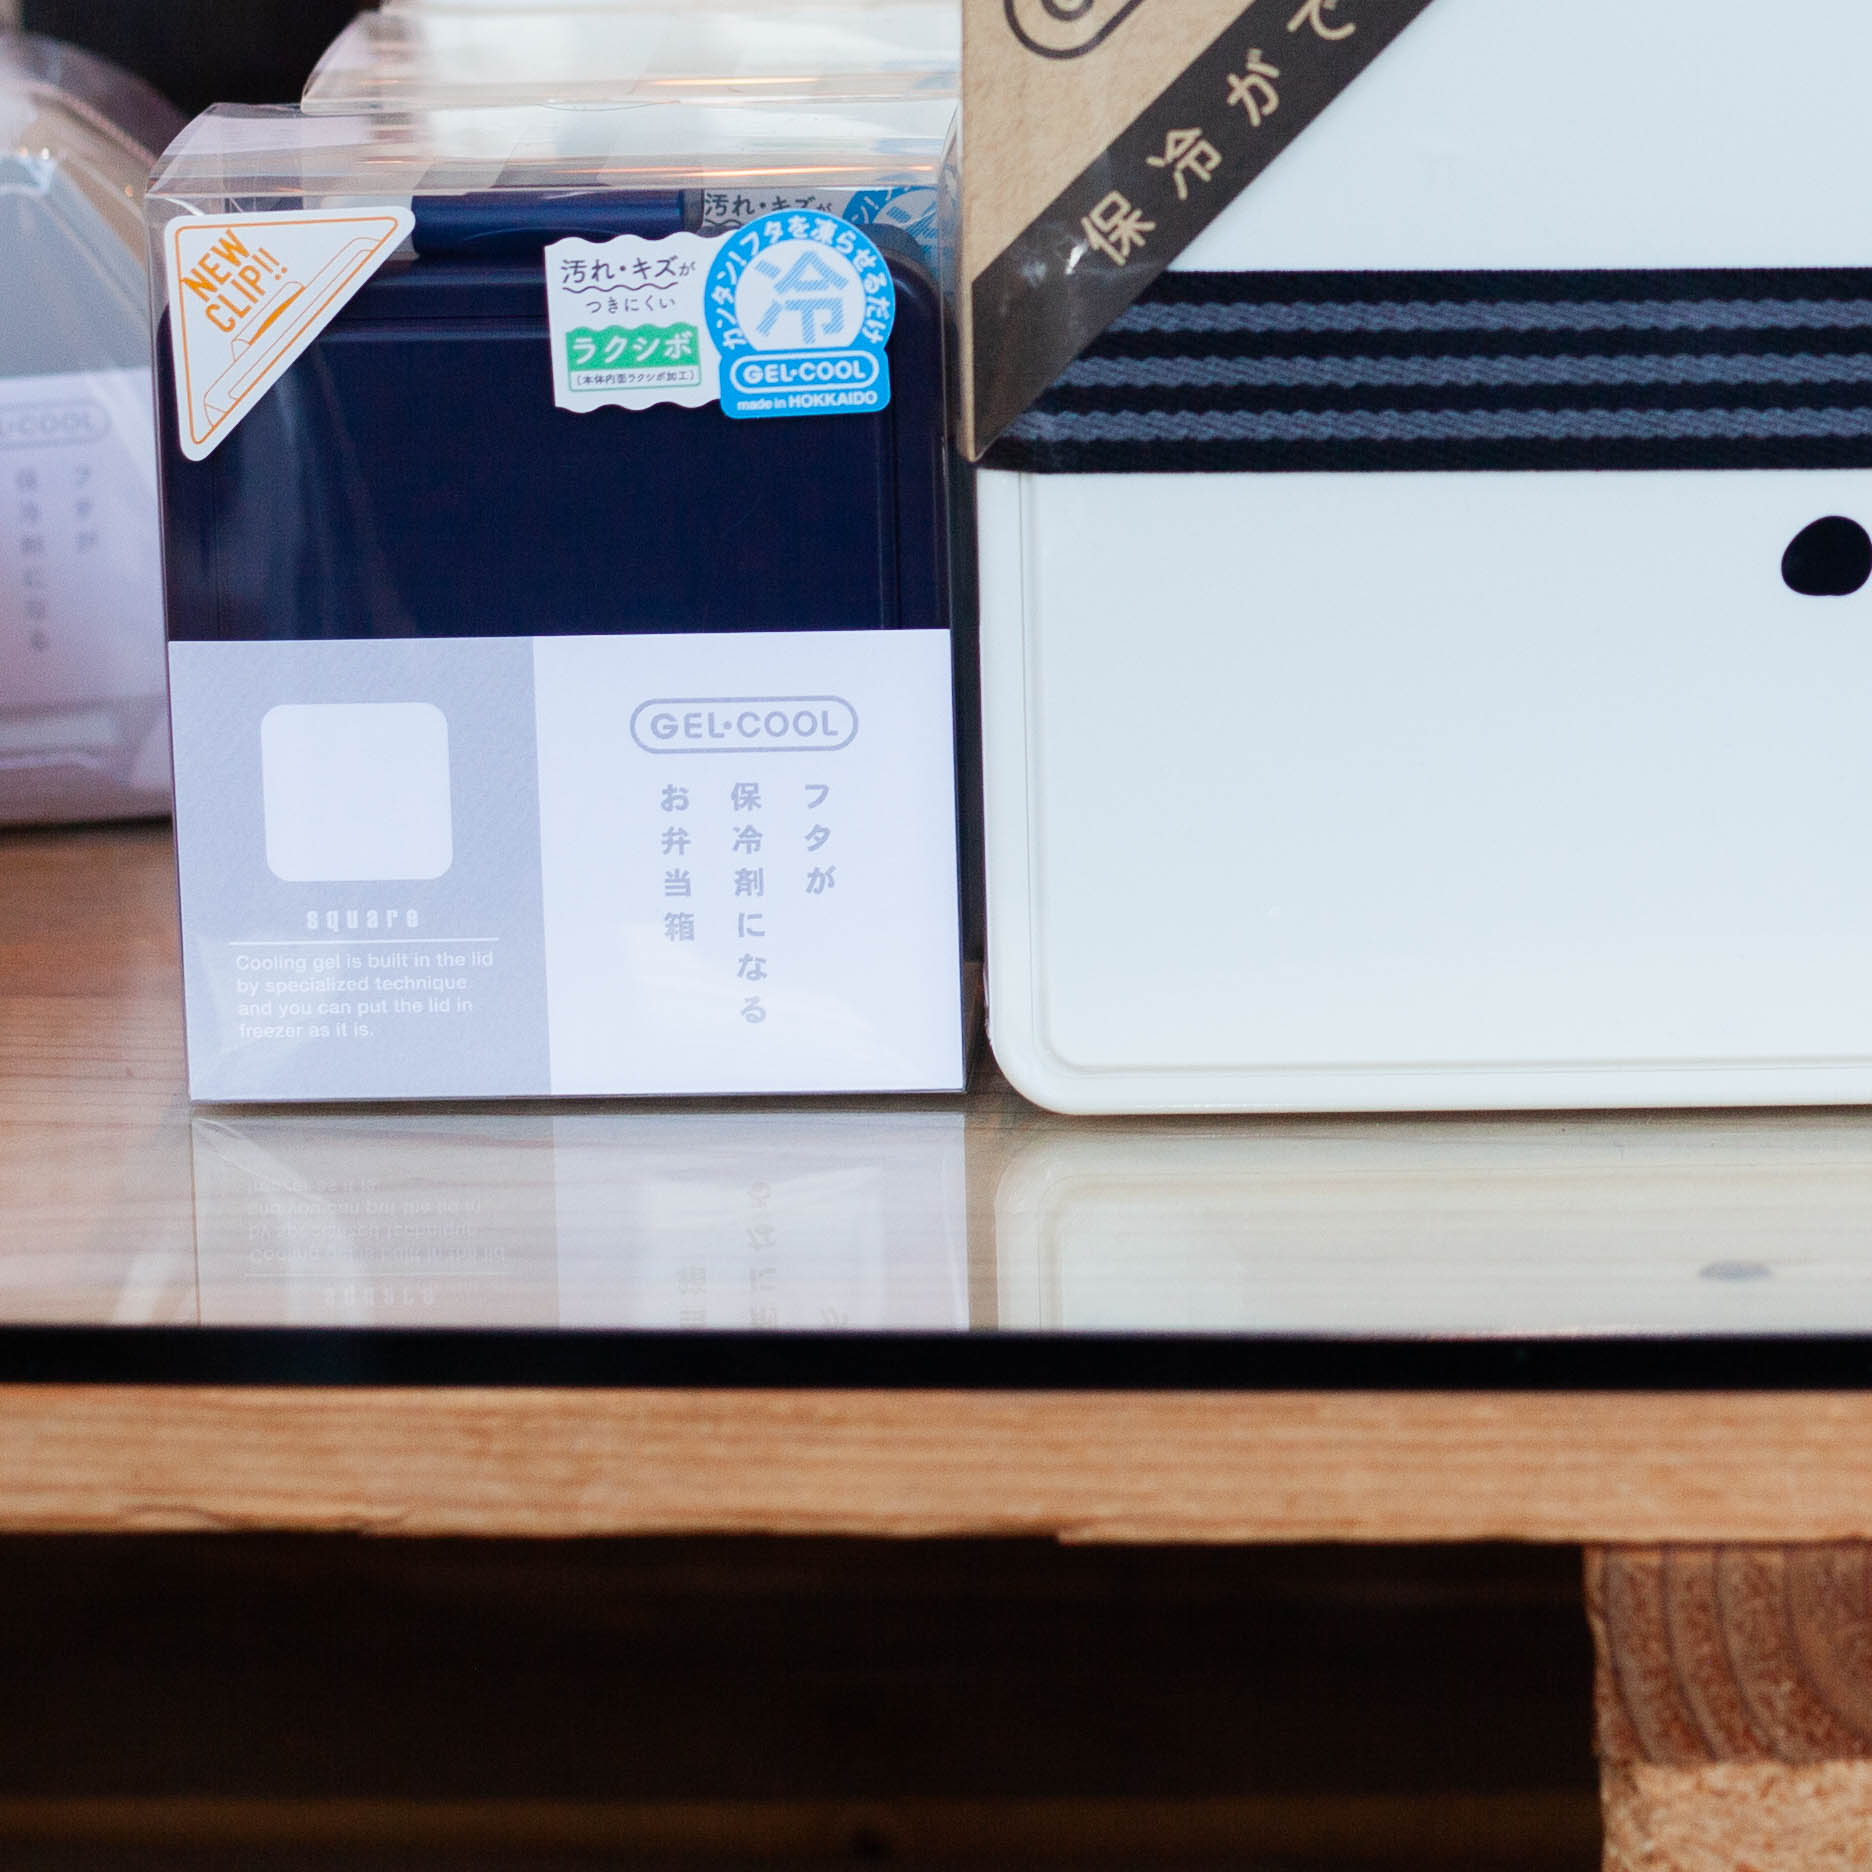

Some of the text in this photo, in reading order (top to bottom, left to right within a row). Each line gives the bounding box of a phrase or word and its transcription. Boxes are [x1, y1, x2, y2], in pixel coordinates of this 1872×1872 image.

[183, 228, 250, 302] NEW
[560, 255, 696, 284] 汚れ・キズが
[205, 247, 288, 333] CLIP!!
[586, 295, 676, 314] つきにくい
[754, 251, 848, 344] 冷
[572, 330, 693, 364] ラクシボ
[737, 390, 878, 410] made in HOKKAIDO
[803, 783, 837, 896] フタが
[660, 783, 696, 942] お弁当箱
[730, 781, 768, 1025] 保冷剤になる
[306, 909, 420, 933] square
[236, 951, 494, 973] Cooling gel is built in the lid
[237, 976, 467, 996] by specialized technique
[239, 998, 473, 1018] and you can put the lid in
[239, 1023, 304, 1038] freezer
[309, 1024, 330, 1037] as
[336, 1022, 348, 1037] it
